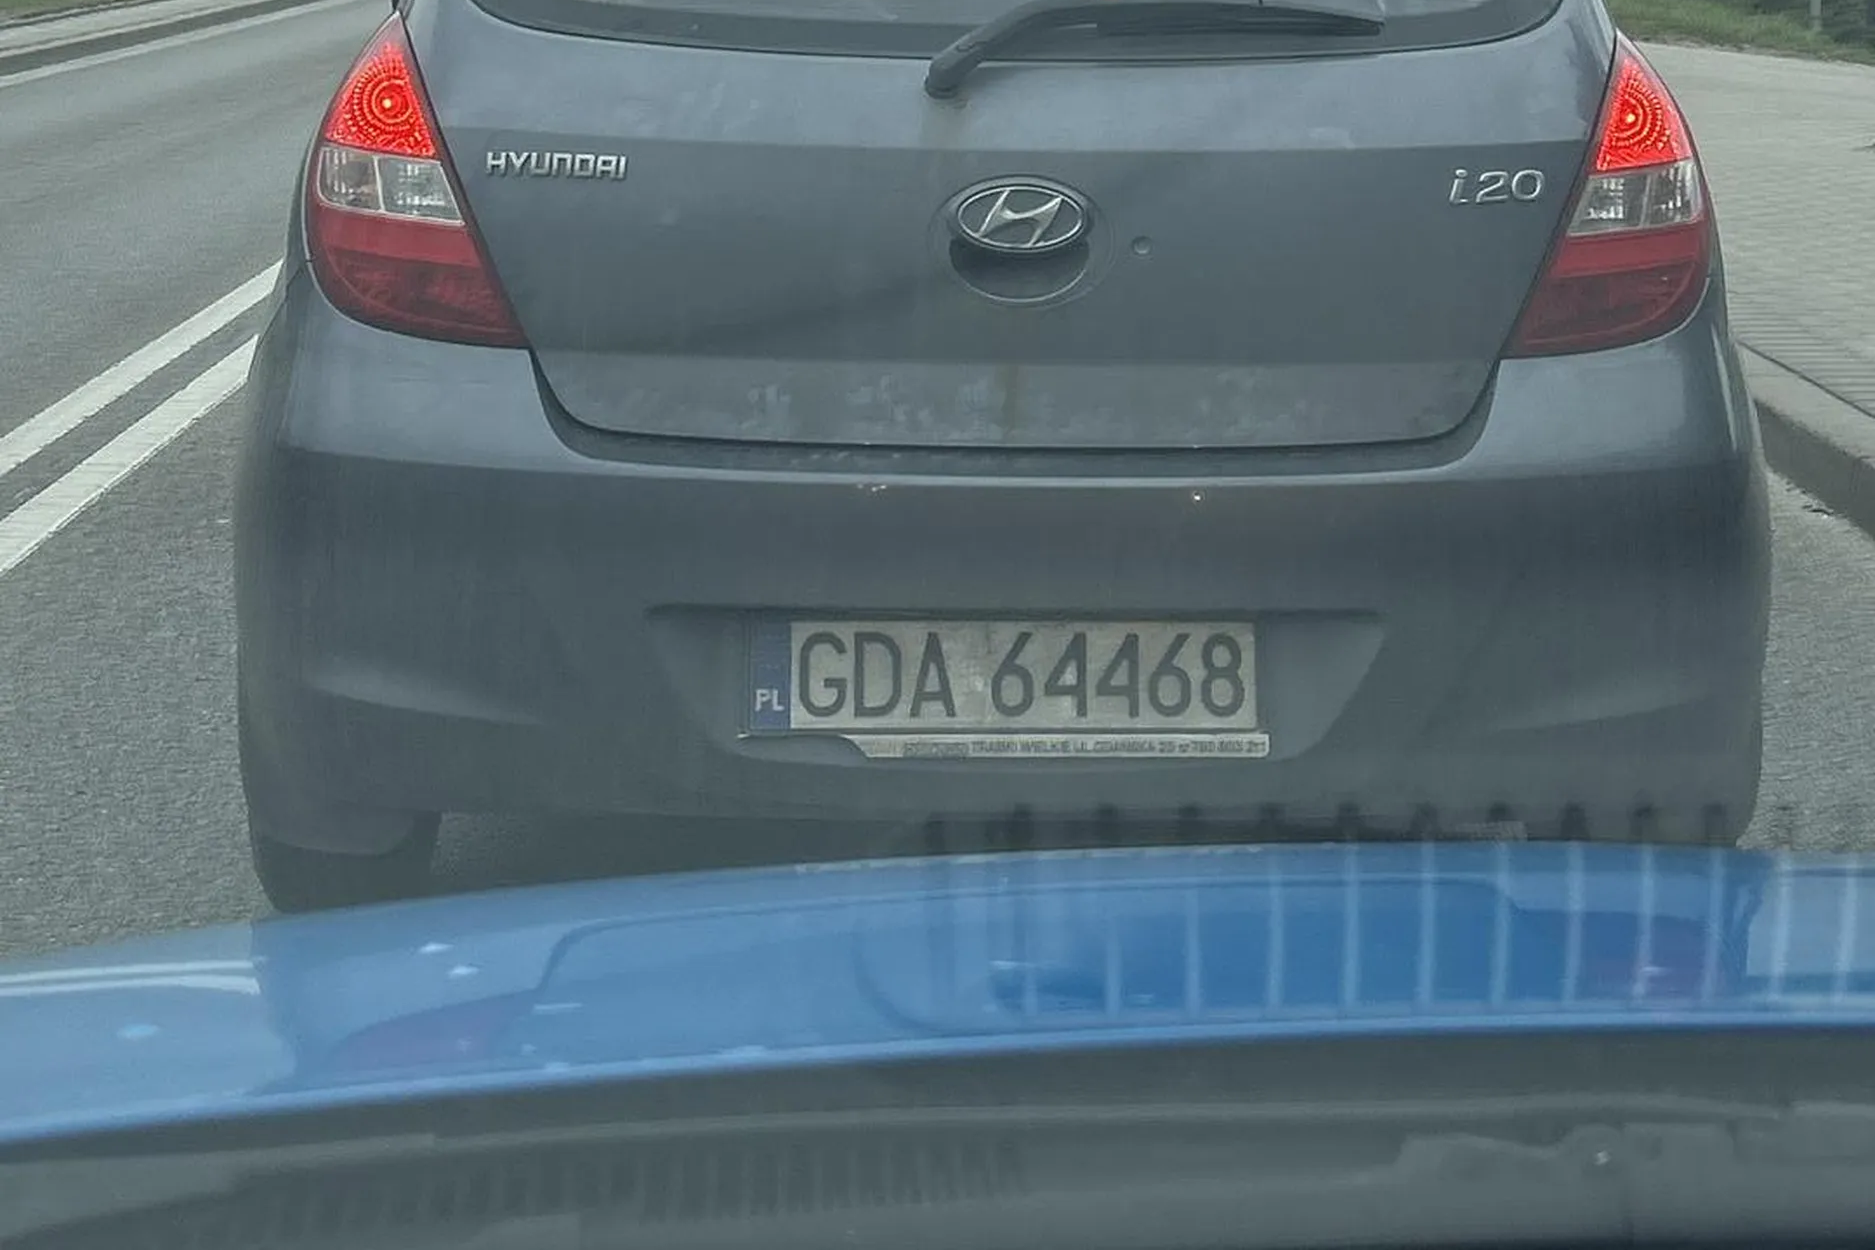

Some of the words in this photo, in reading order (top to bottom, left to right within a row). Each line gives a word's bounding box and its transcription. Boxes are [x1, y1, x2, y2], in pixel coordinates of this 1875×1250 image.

[485, 152, 627, 180] HYUNDAI
[1448, 168, 1545, 204] i20
[798, 630, 956, 719] GDA
[990, 631, 1245, 718] 64468
[755, 688, 785, 712] PL
